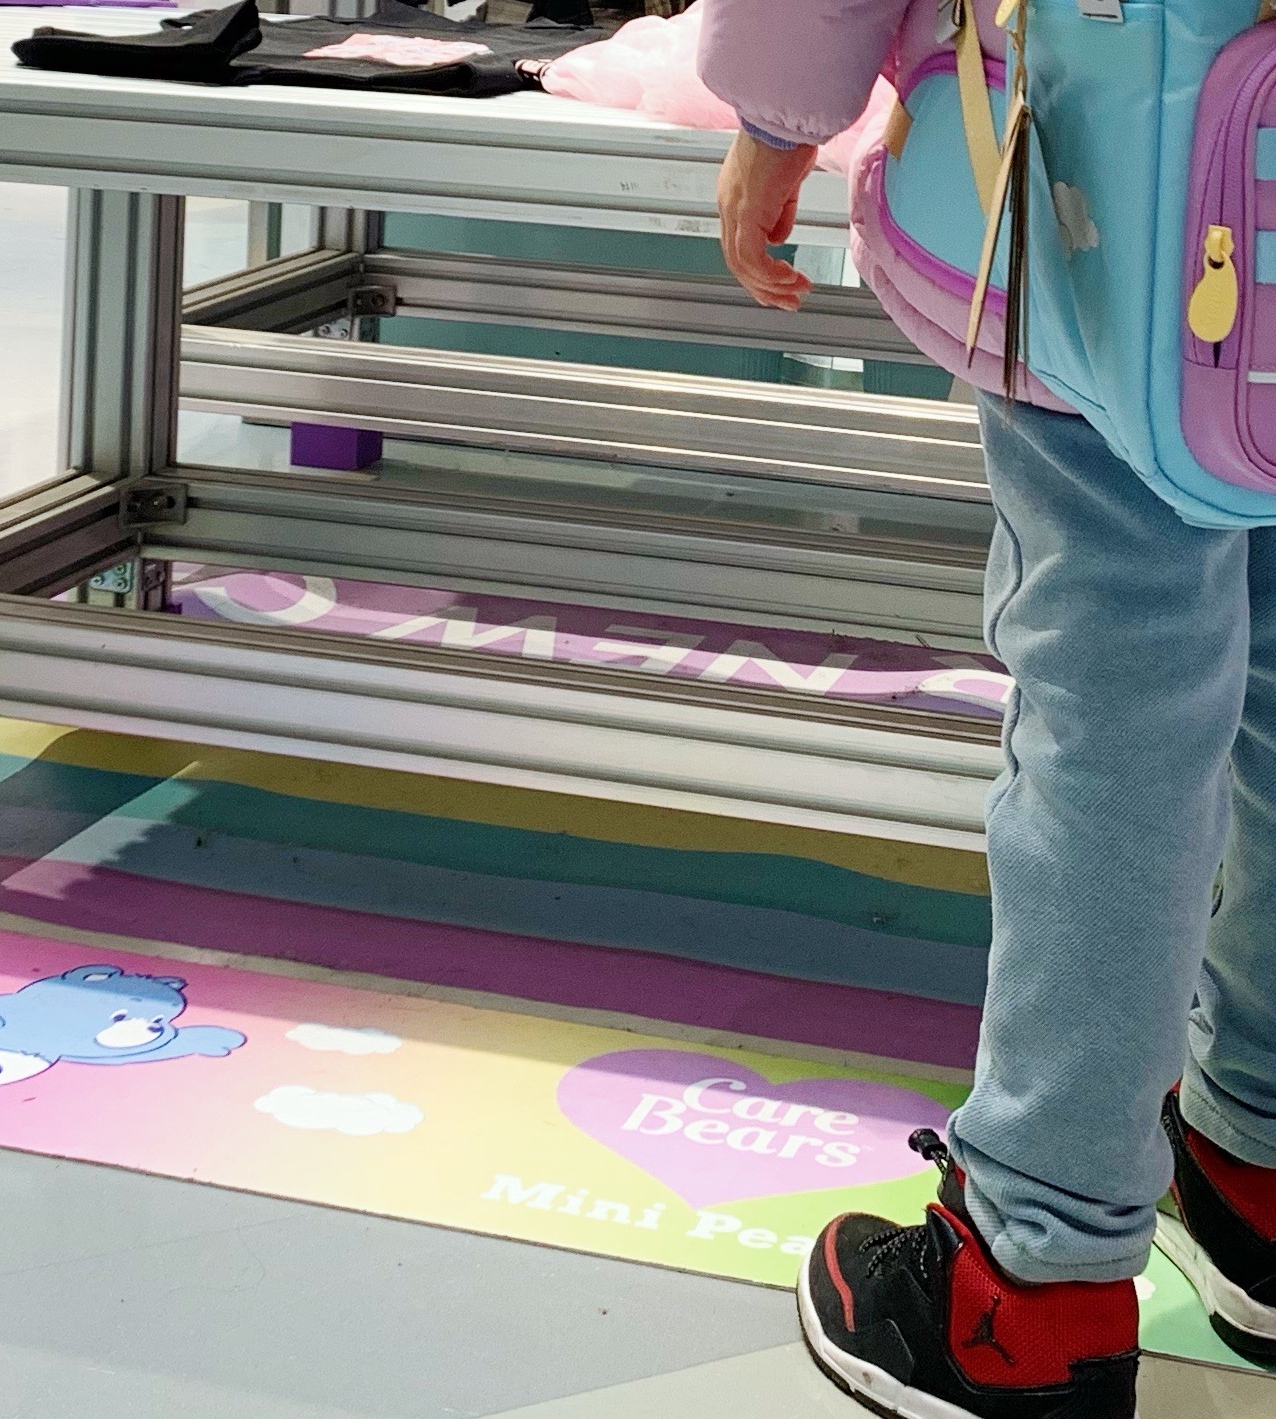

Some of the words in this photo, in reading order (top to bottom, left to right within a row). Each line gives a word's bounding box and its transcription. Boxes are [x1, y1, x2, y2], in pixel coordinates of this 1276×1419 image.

[620, 1092, 863, 1168] Bears
[681, 1077, 860, 1136] Care
[480, 1174, 667, 1230] Mini
